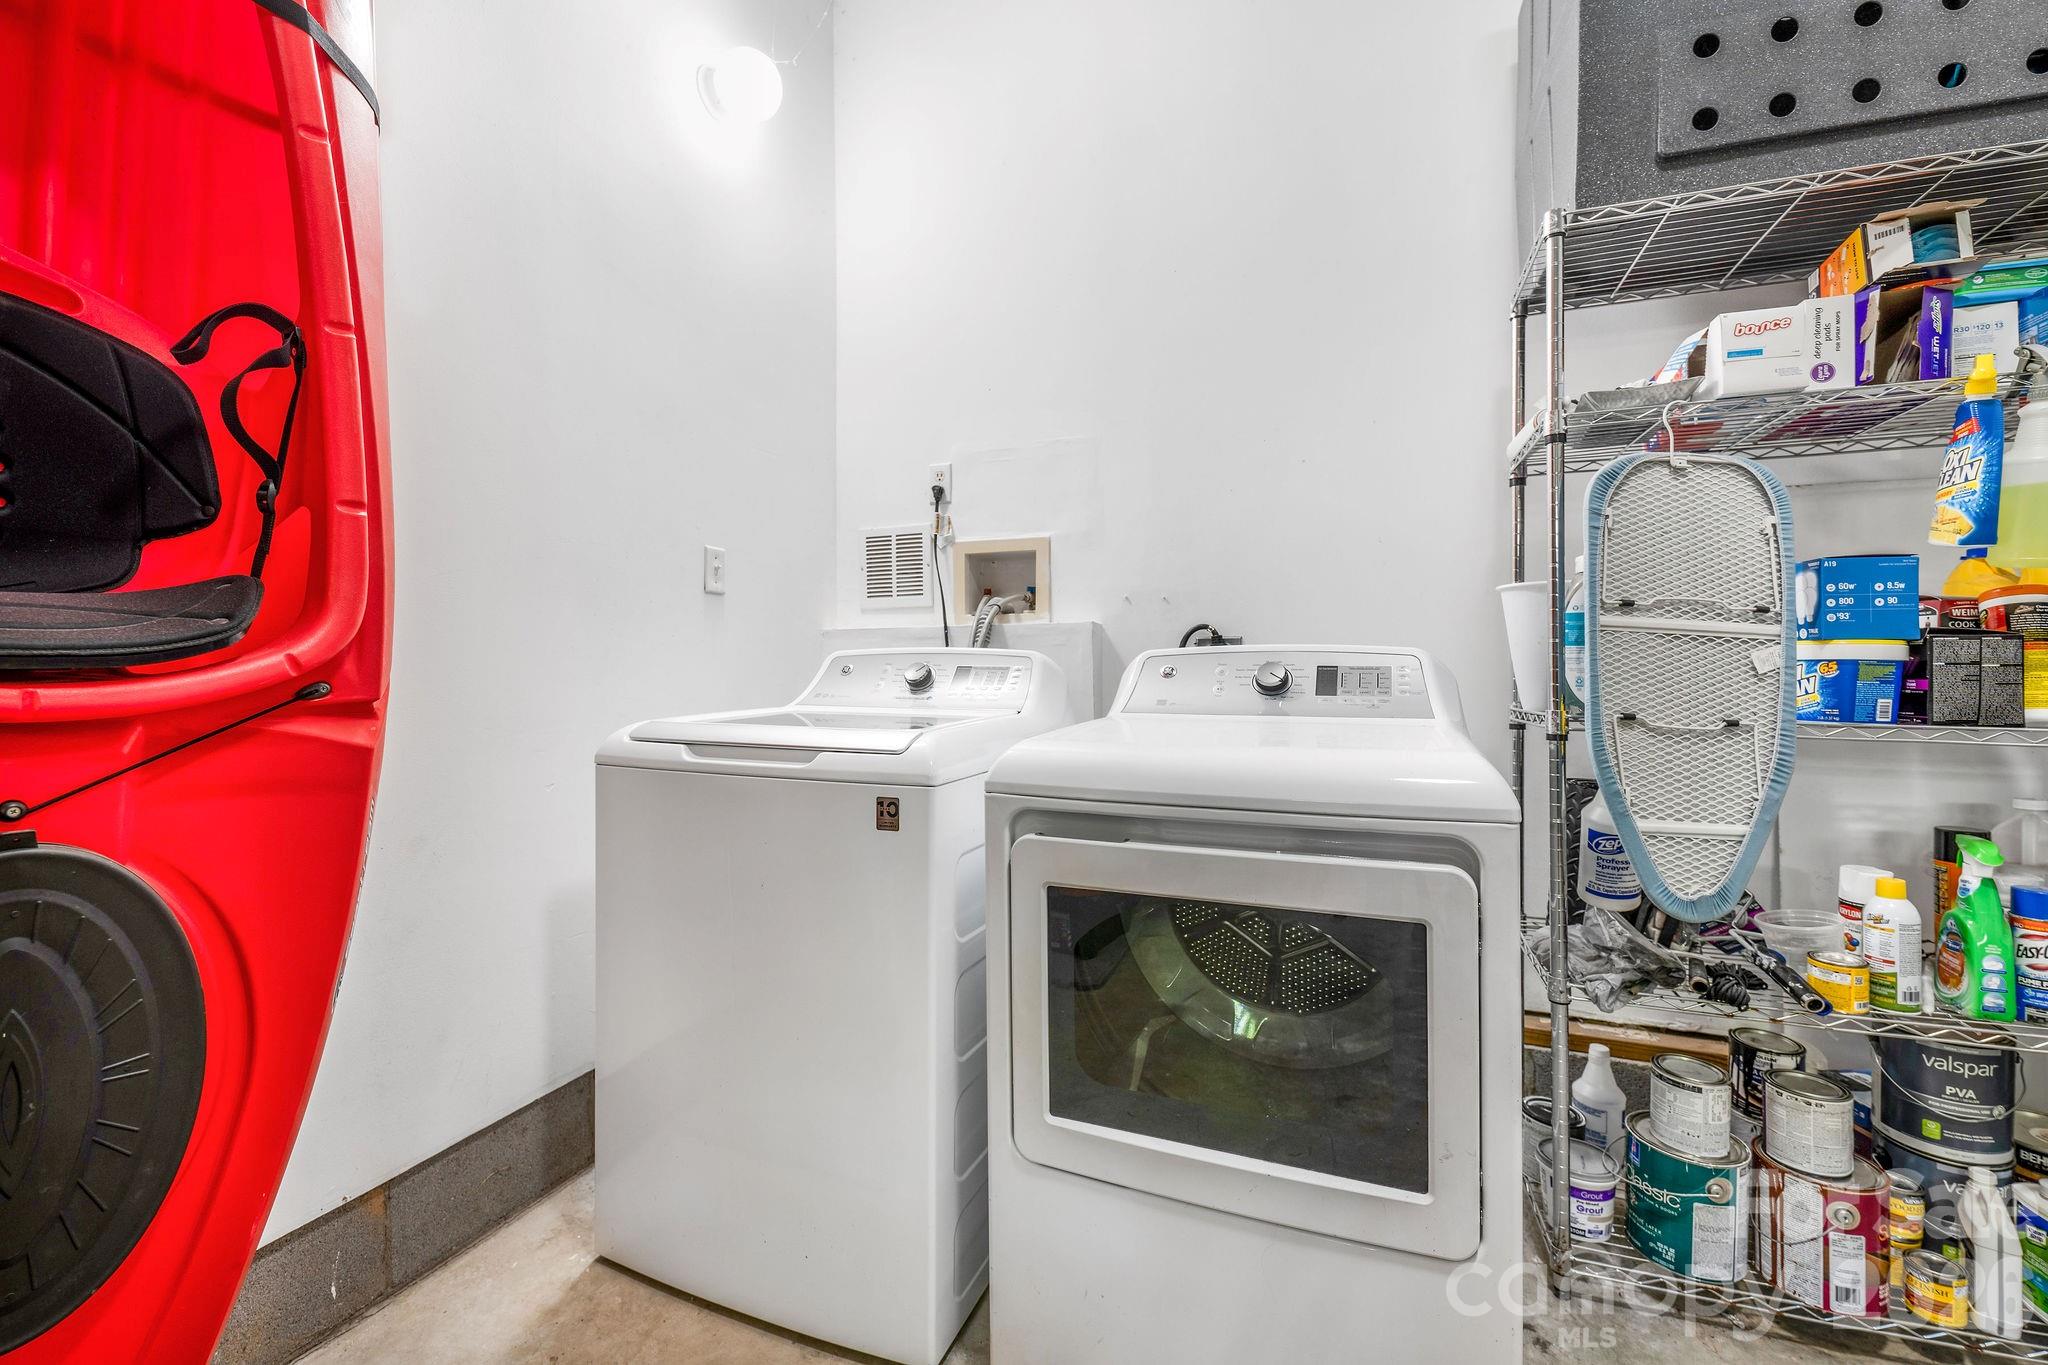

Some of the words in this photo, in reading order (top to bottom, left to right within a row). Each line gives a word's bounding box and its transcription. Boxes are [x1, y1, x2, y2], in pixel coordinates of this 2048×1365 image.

[1813, 307, 1824, 339] cleaning
[1929, 295, 1942, 335] Swiffer
[1734, 317, 1792, 337] bounce
[1823, 322, 1833, 342] pads
[1813, 340, 1823, 360] deep
[1943, 446, 1971, 472] OXI
[1937, 458, 1983, 492] LEAN
[1824, 560, 1837, 568] A19
[1948, 620, 1977, 628] COOK
[1819, 661, 1838, 673] 65
[1595, 861, 1630, 873] Sprayer
[1921, 1053, 1999, 1079] valspar
[1945, 1085, 1977, 1100] PVA
[2020, 1149, 2048, 1166] BEH
[1580, 1191, 1603, 1200] Grout
[1576, 1204, 1604, 1214] Grout
